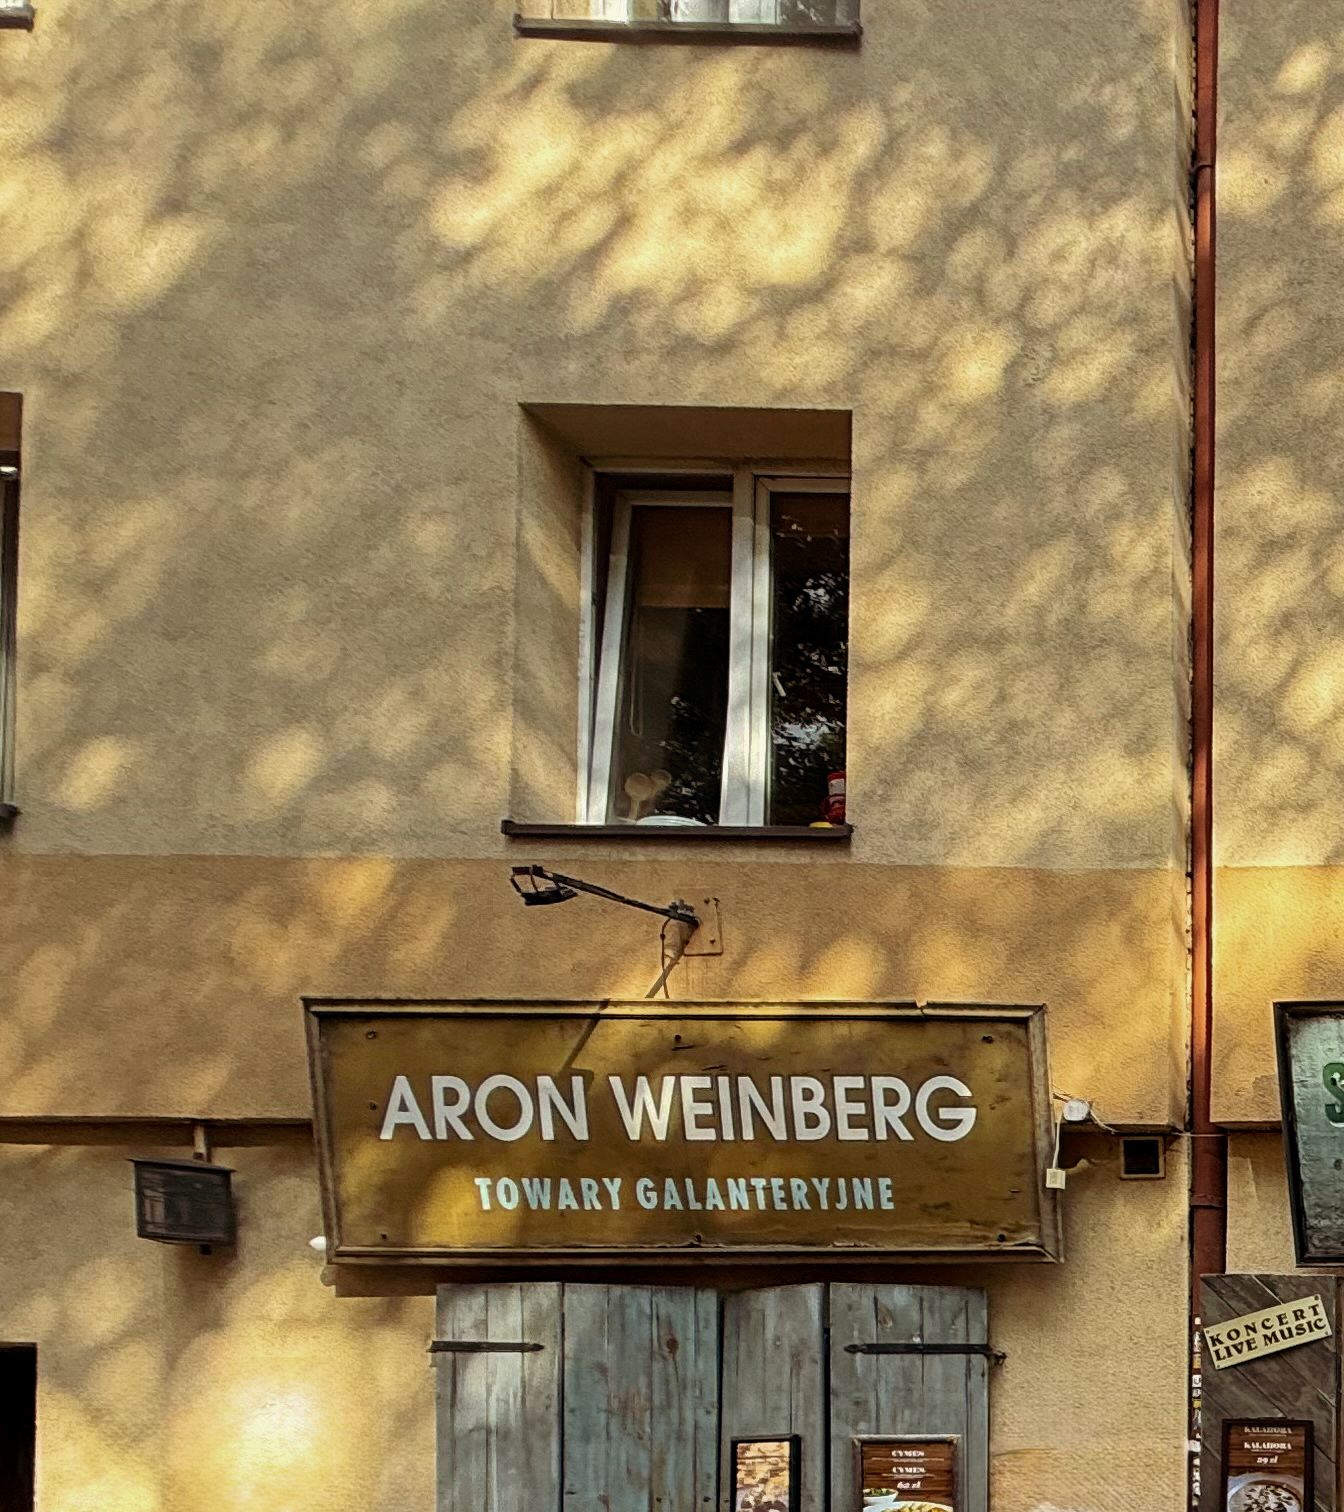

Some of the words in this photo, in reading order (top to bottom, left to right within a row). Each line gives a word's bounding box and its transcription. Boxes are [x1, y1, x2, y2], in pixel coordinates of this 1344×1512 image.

[379, 1074, 591, 1142] ARON
[608, 1073, 978, 1142] WEINBERG
[474, 1176, 621, 1211] TOWARY
[635, 1176, 895, 1211] GALANTERYJNE
[1209, 1304, 1319, 1347] KONCERT
[1213, 1338, 1258, 1361] LIVE
[1263, 1318, 1327, 1346] MUSIC
